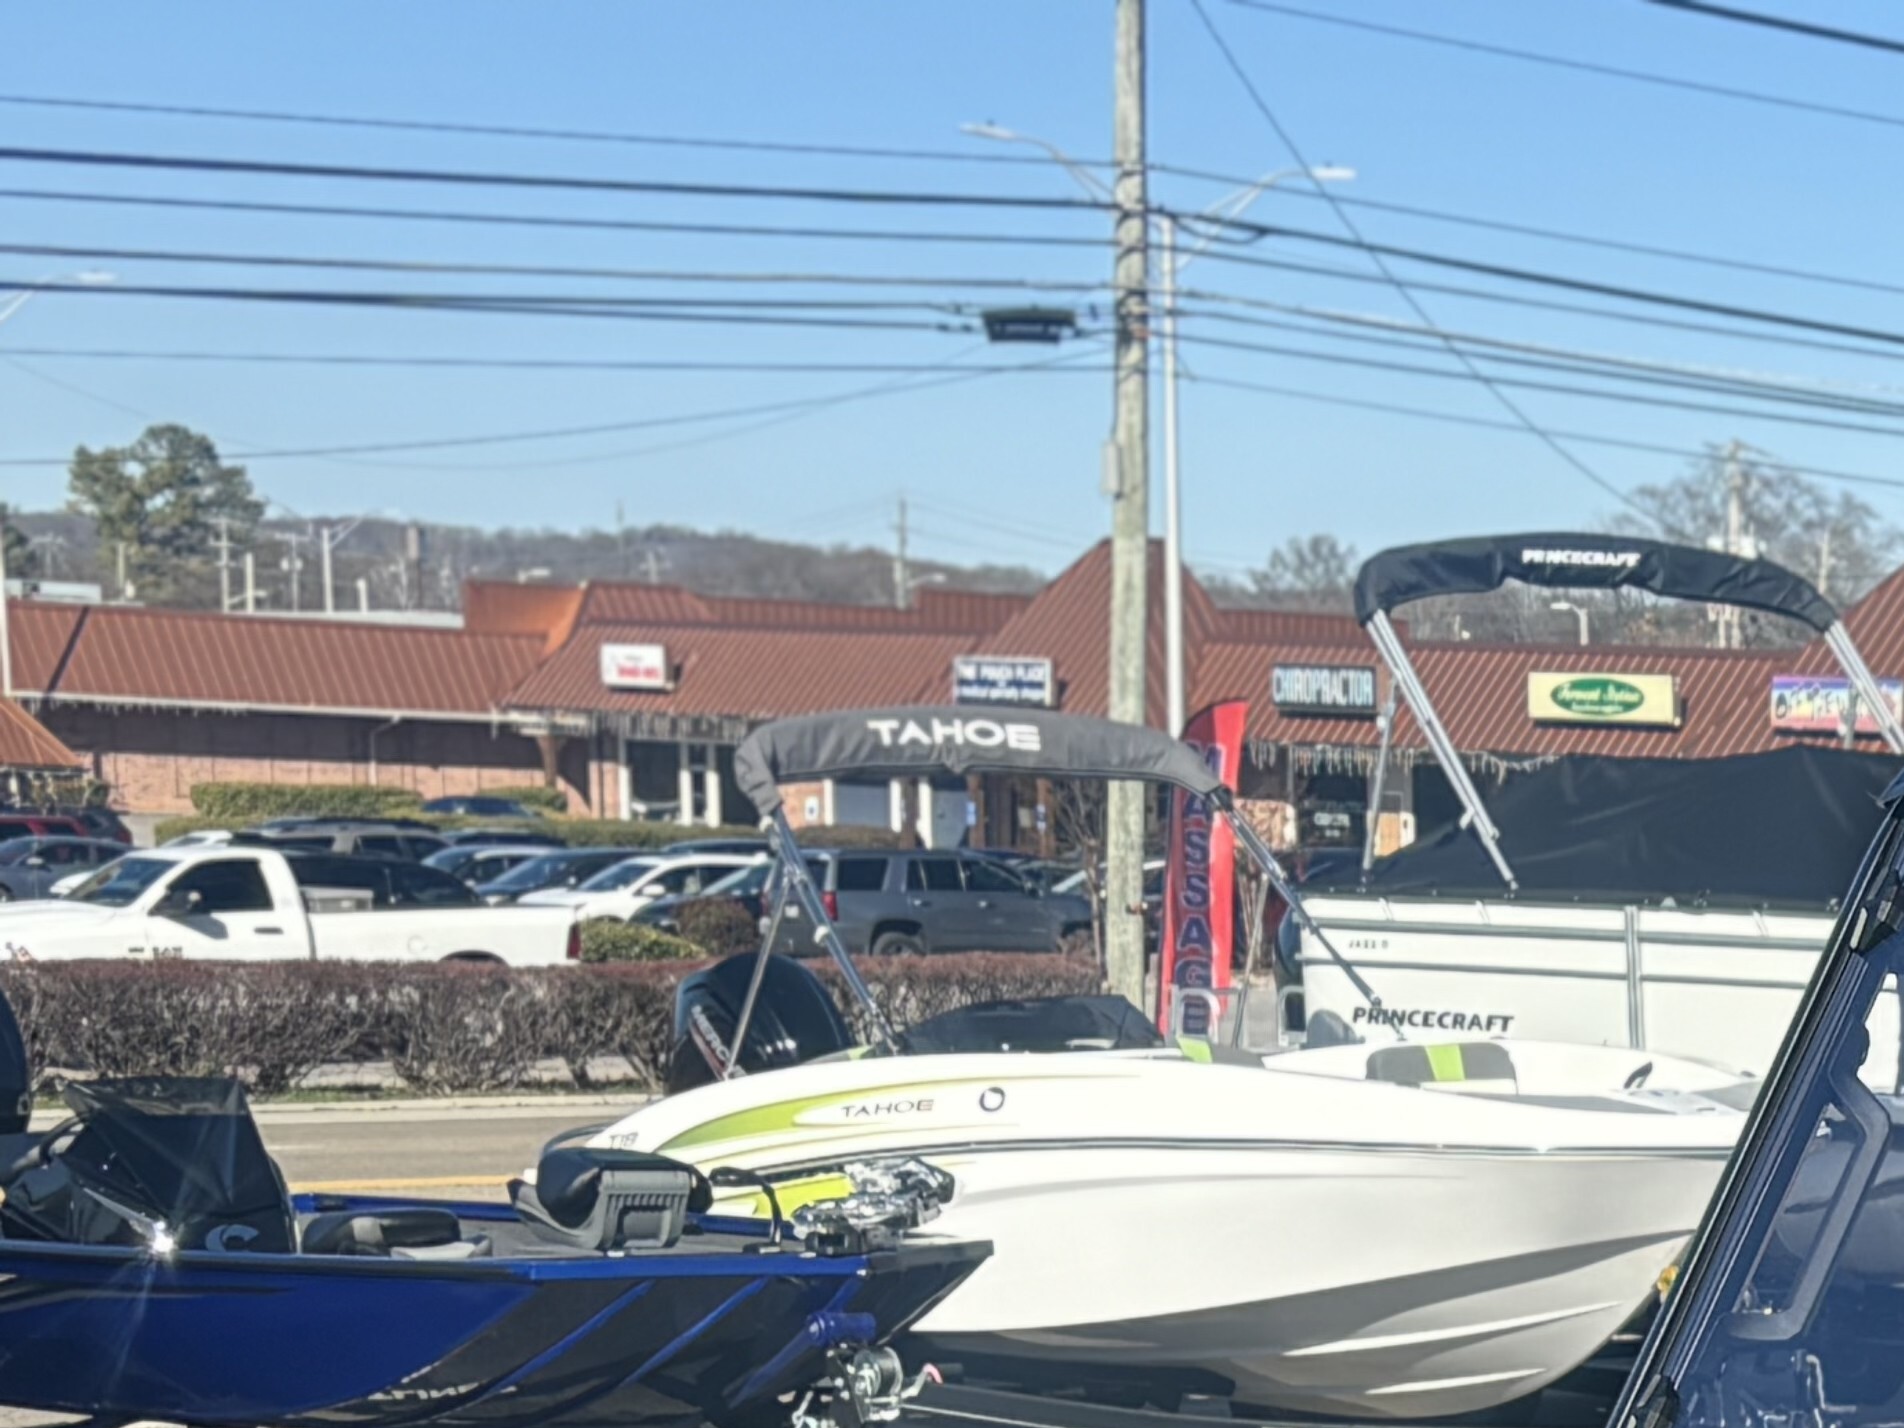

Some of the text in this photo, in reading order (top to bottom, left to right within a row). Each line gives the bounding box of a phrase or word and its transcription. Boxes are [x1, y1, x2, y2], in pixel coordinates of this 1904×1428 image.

[1271, 665, 1374, 707] CHIROPRACTOR
[866, 718, 1042, 752] TAHOE
[1351, 1006, 1515, 1033] PRINCECRAFT
[841, 1098, 935, 1119] TAHOE
